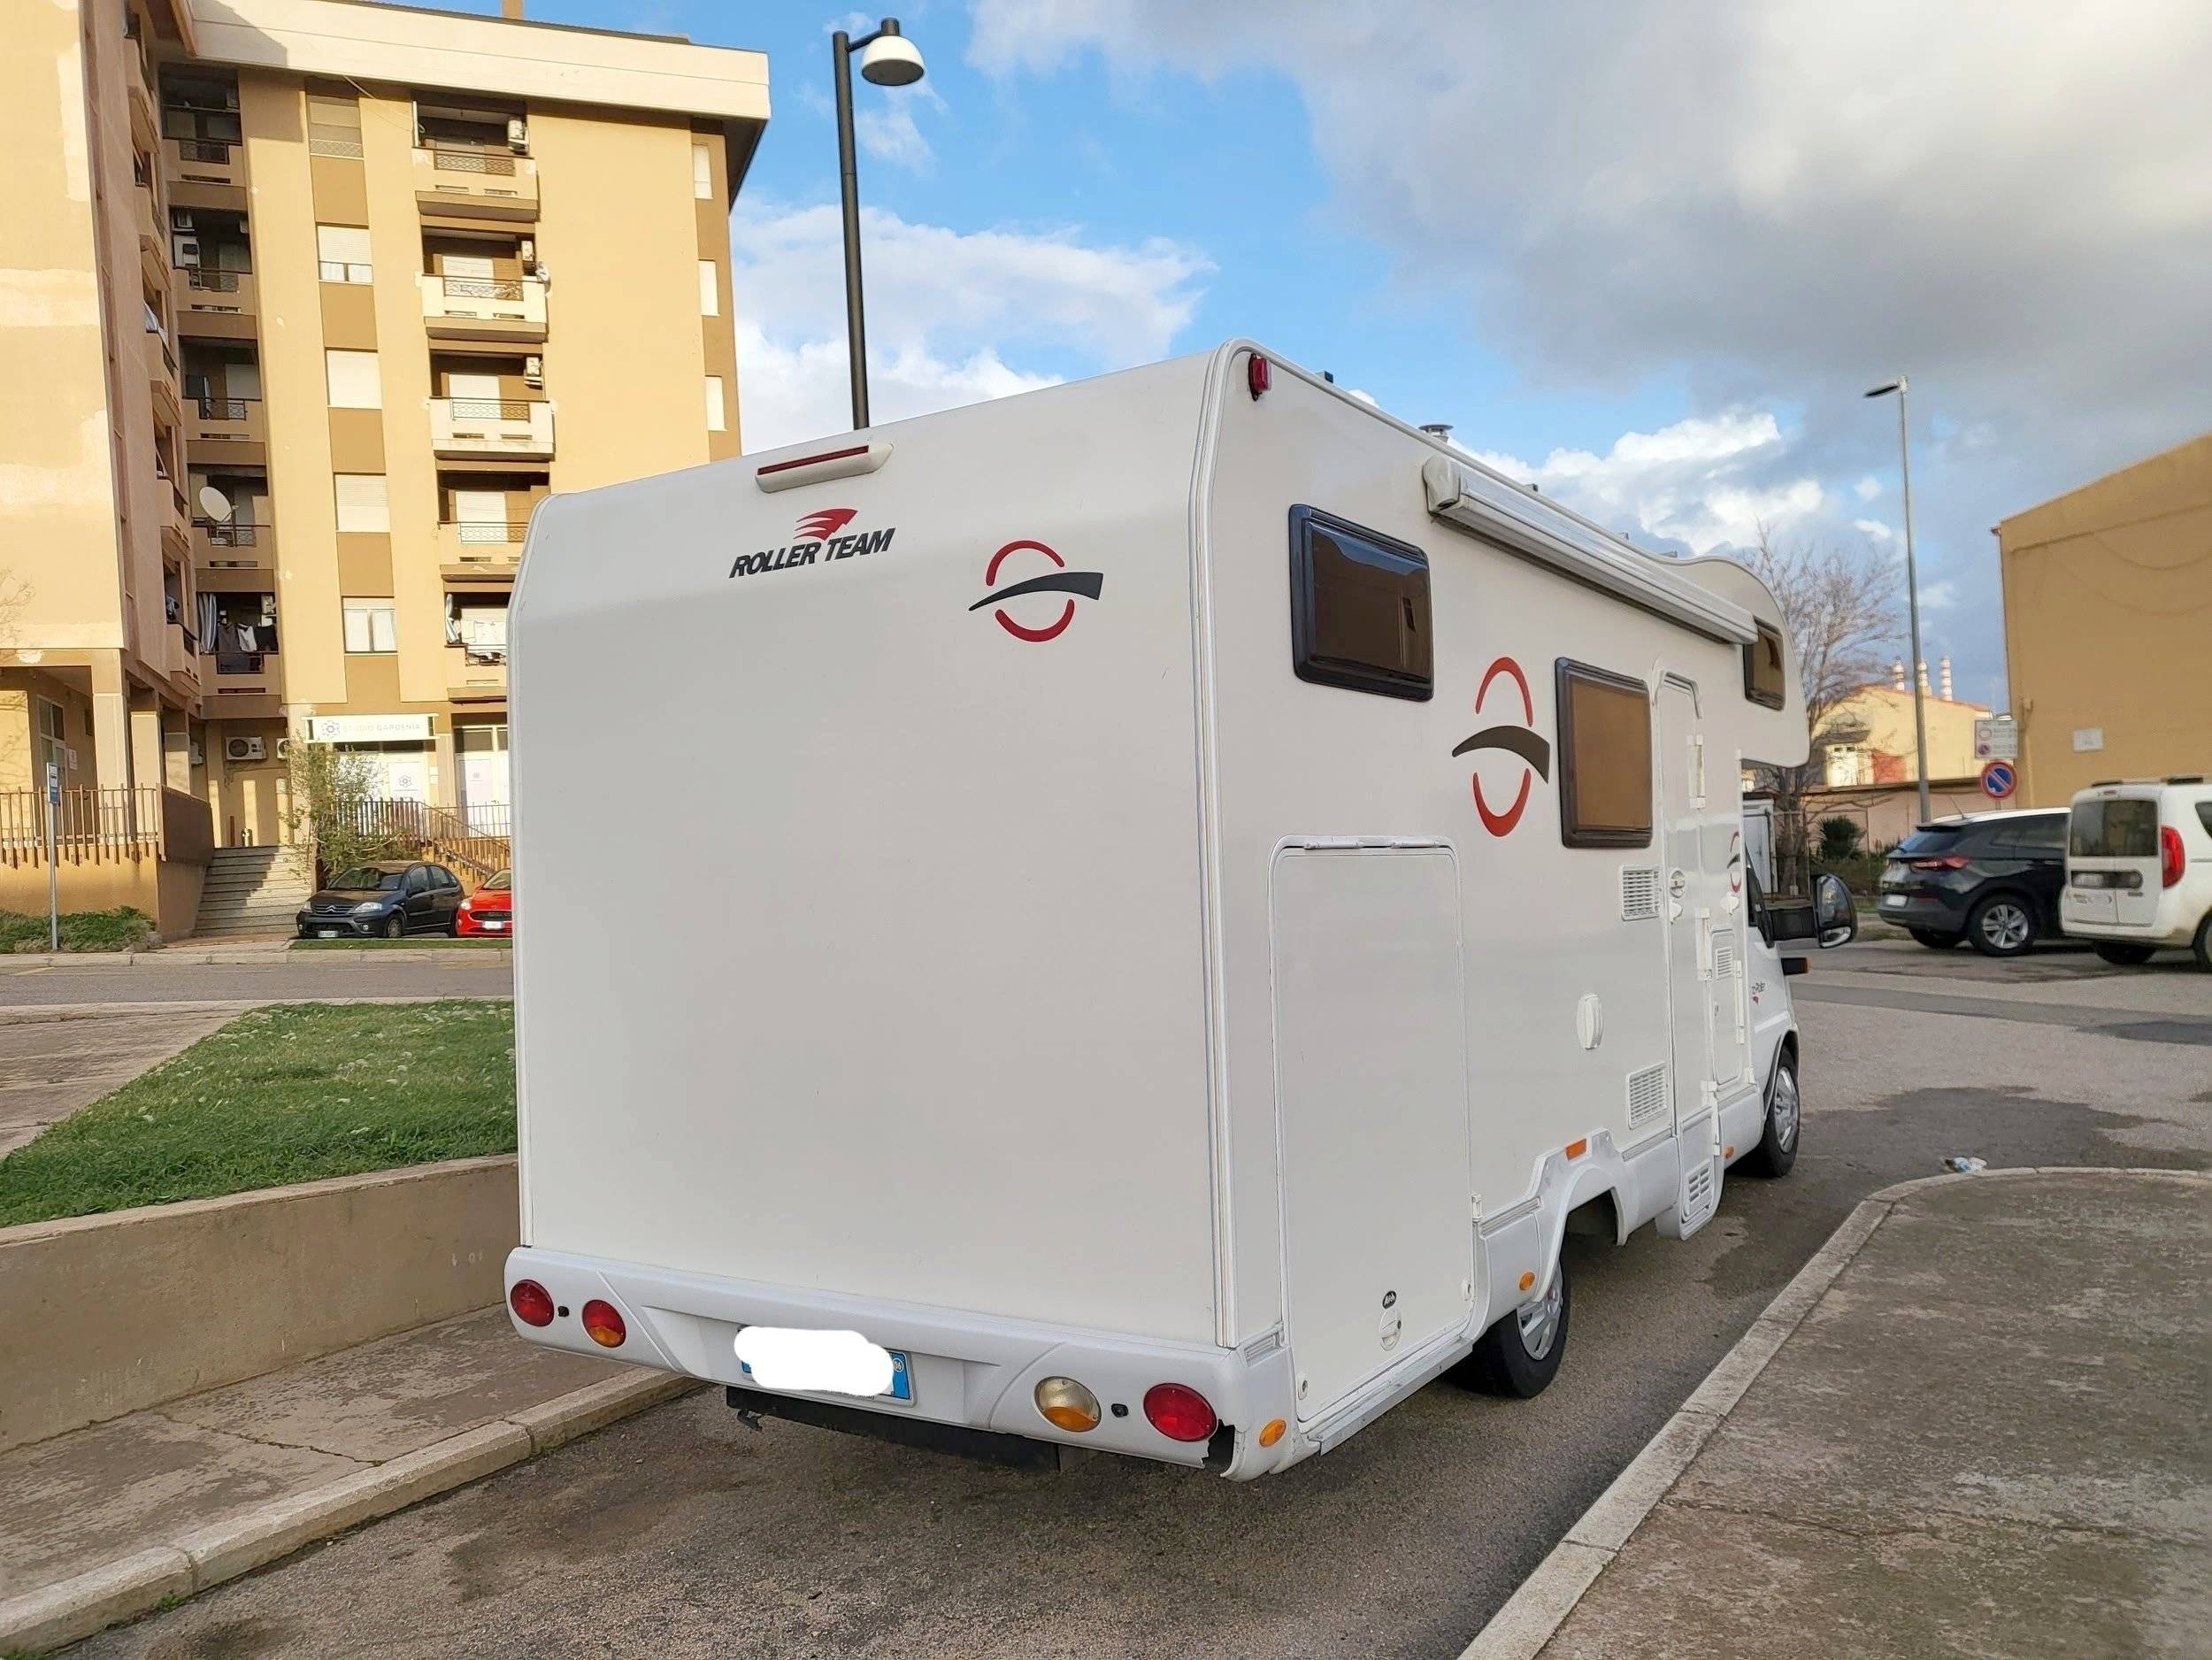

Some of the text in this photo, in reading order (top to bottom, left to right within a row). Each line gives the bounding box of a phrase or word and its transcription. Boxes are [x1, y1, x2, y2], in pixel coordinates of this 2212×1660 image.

[729, 527, 895, 578] ROLLER TEAM
[376, 723, 421, 732] GARDENIA
